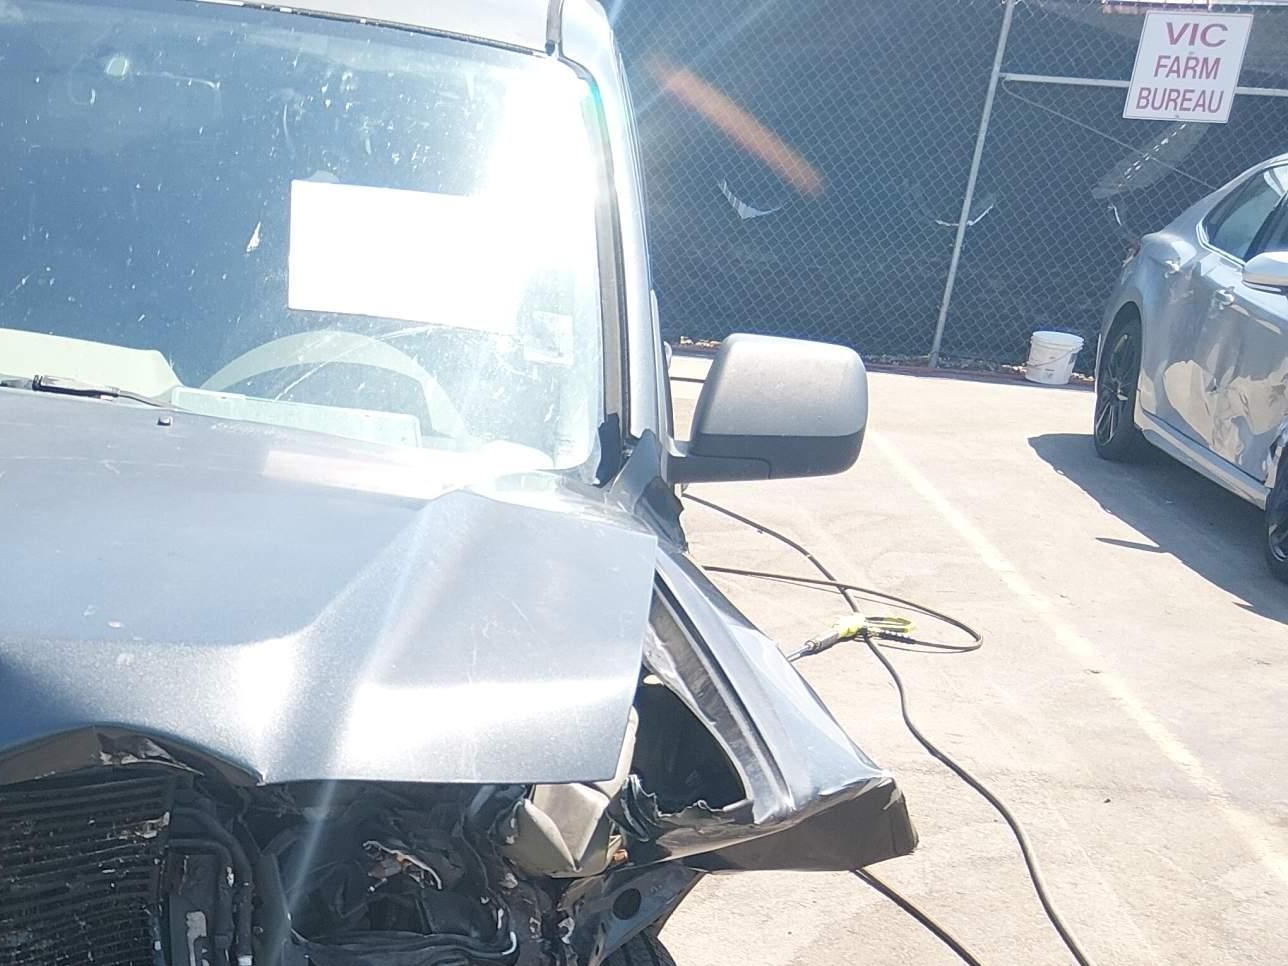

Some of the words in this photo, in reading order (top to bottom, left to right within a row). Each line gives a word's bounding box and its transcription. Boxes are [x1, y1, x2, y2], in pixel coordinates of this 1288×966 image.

[1166, 22, 1228, 47] VIC
[1154, 55, 1221, 80] FARM
[1135, 87, 1225, 114] BUREAU
